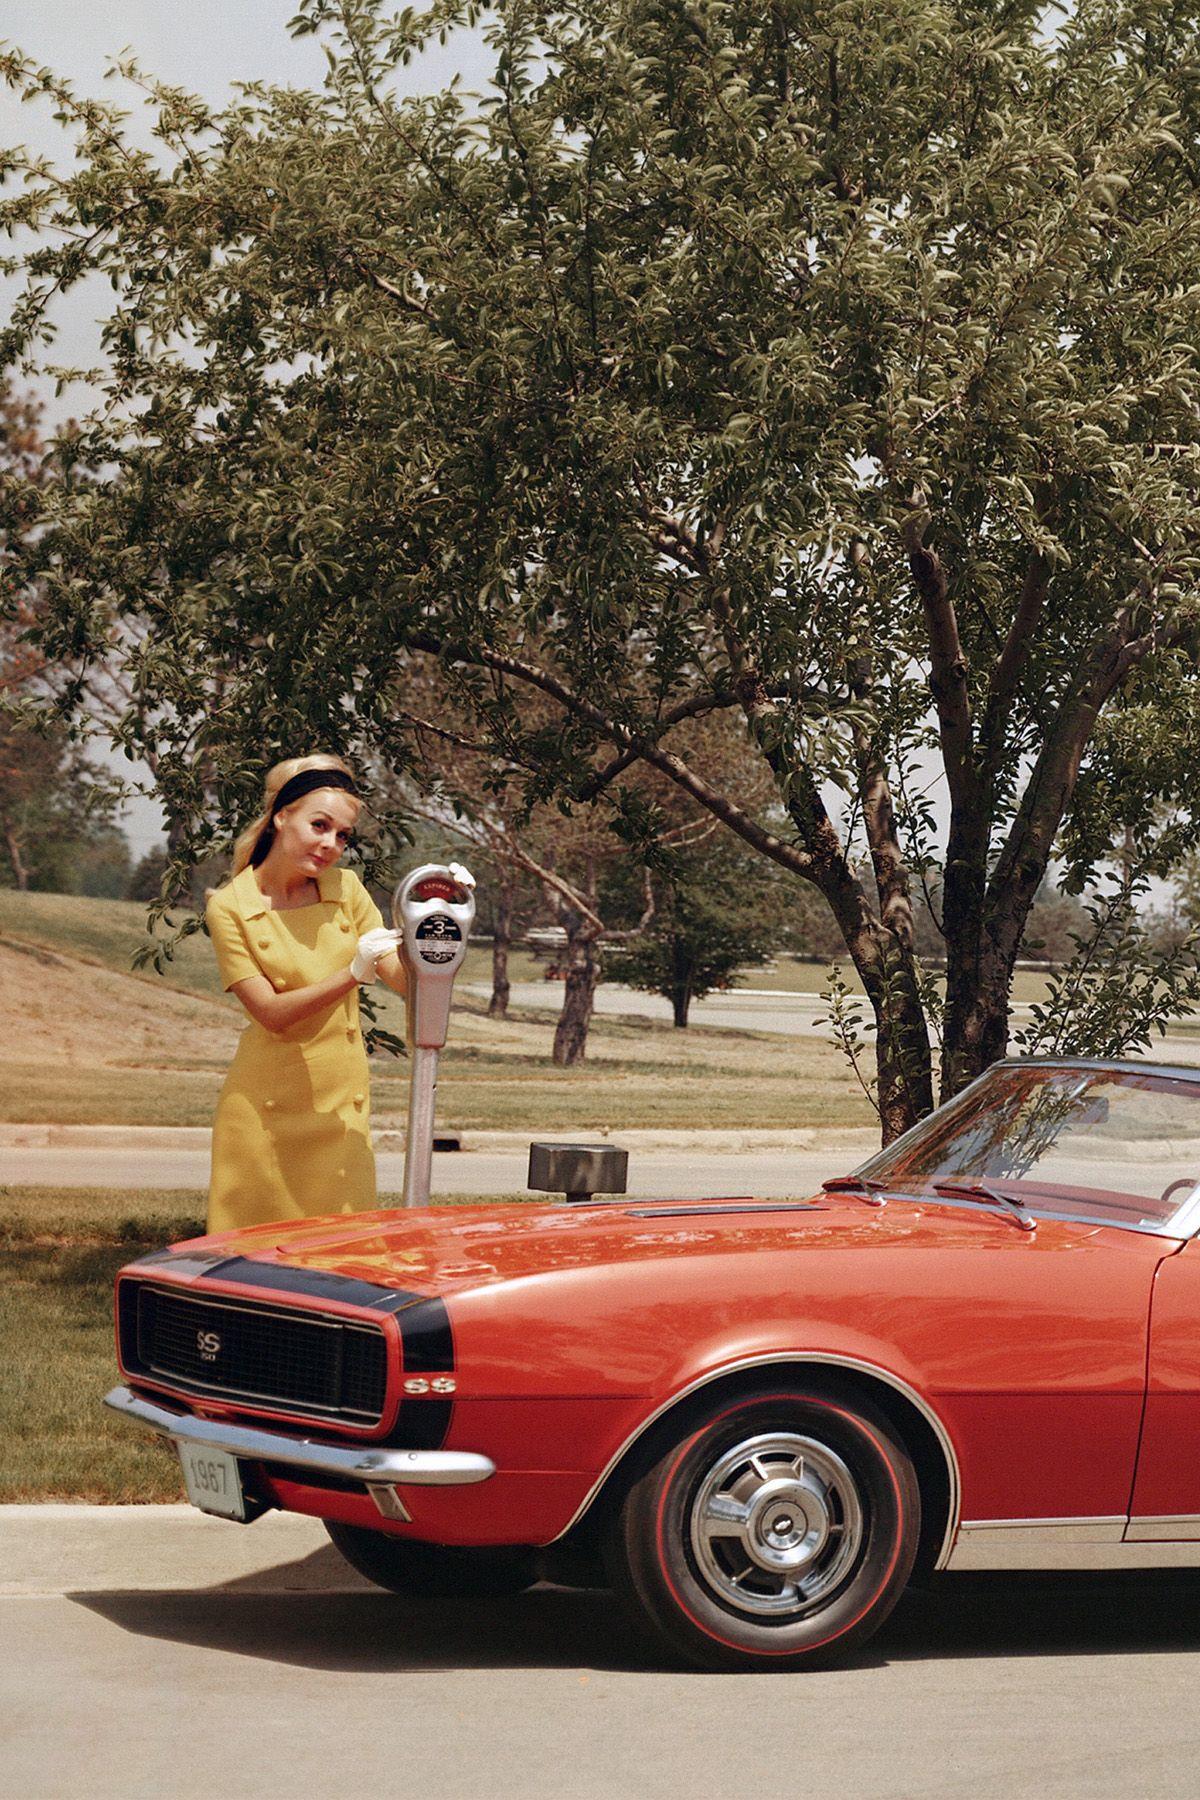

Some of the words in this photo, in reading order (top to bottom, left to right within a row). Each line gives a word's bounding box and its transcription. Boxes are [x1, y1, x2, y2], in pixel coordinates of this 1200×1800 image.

[433, 921, 445, 934] 3
[196, 1331, 220, 1352] SS
[403, 1377, 457, 1395] SS
[190, 1459, 228, 1496] 1967
